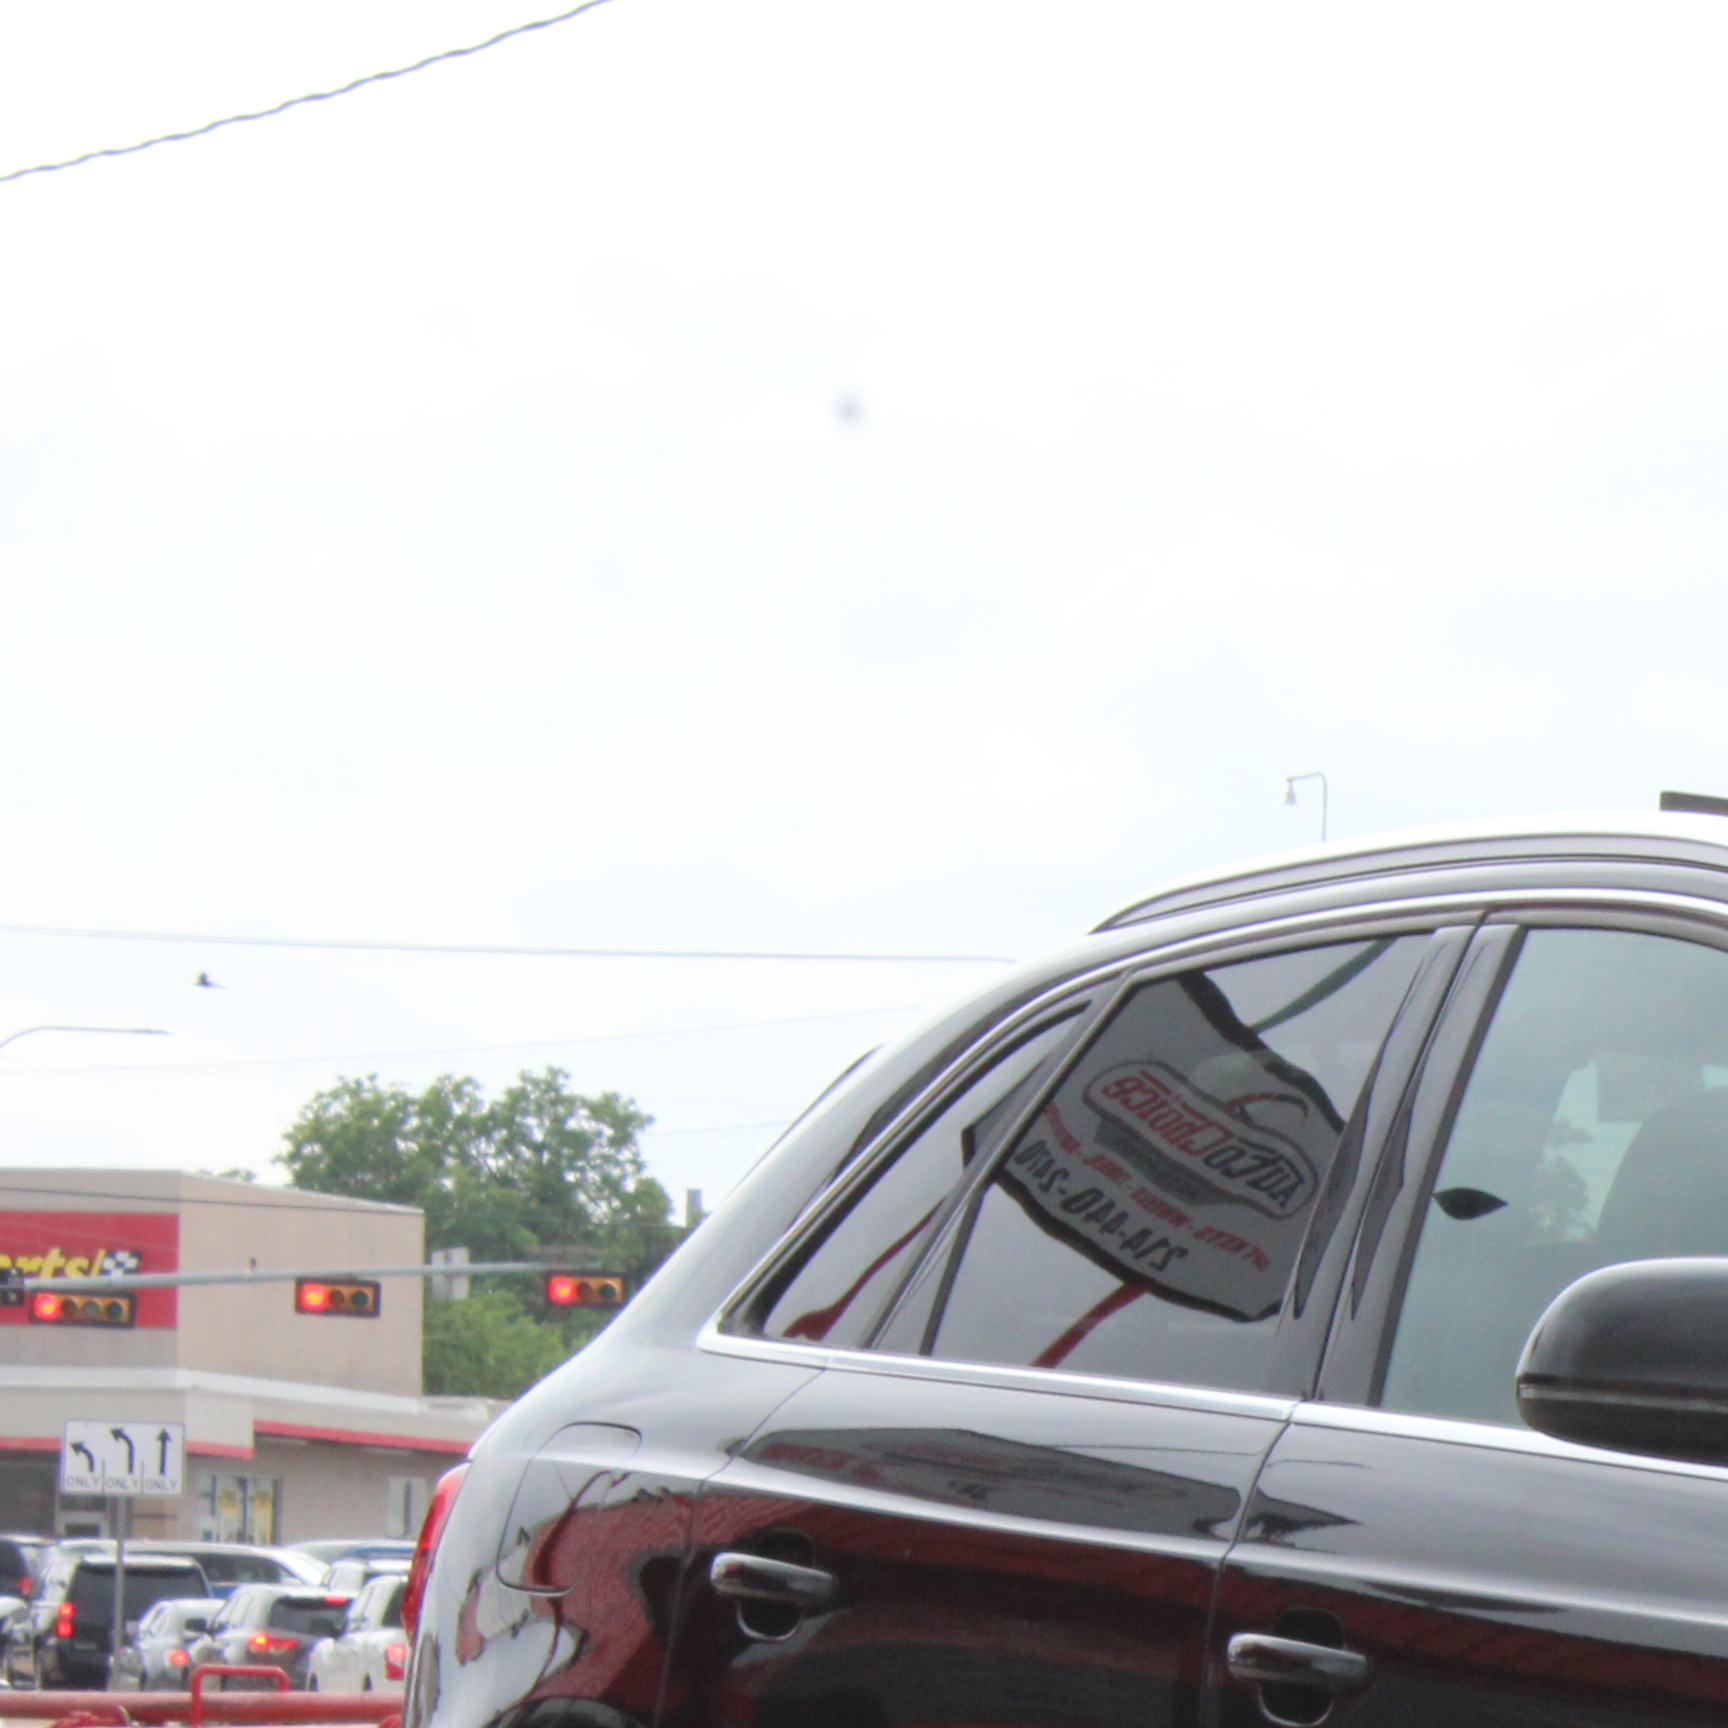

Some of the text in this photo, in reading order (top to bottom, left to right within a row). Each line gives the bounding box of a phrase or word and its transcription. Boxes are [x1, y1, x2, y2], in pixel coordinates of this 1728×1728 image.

[66, 1476, 100, 1488] ONLY
[104, 1477, 140, 1489] ONLY
[145, 1478, 179, 1490] ONLY
